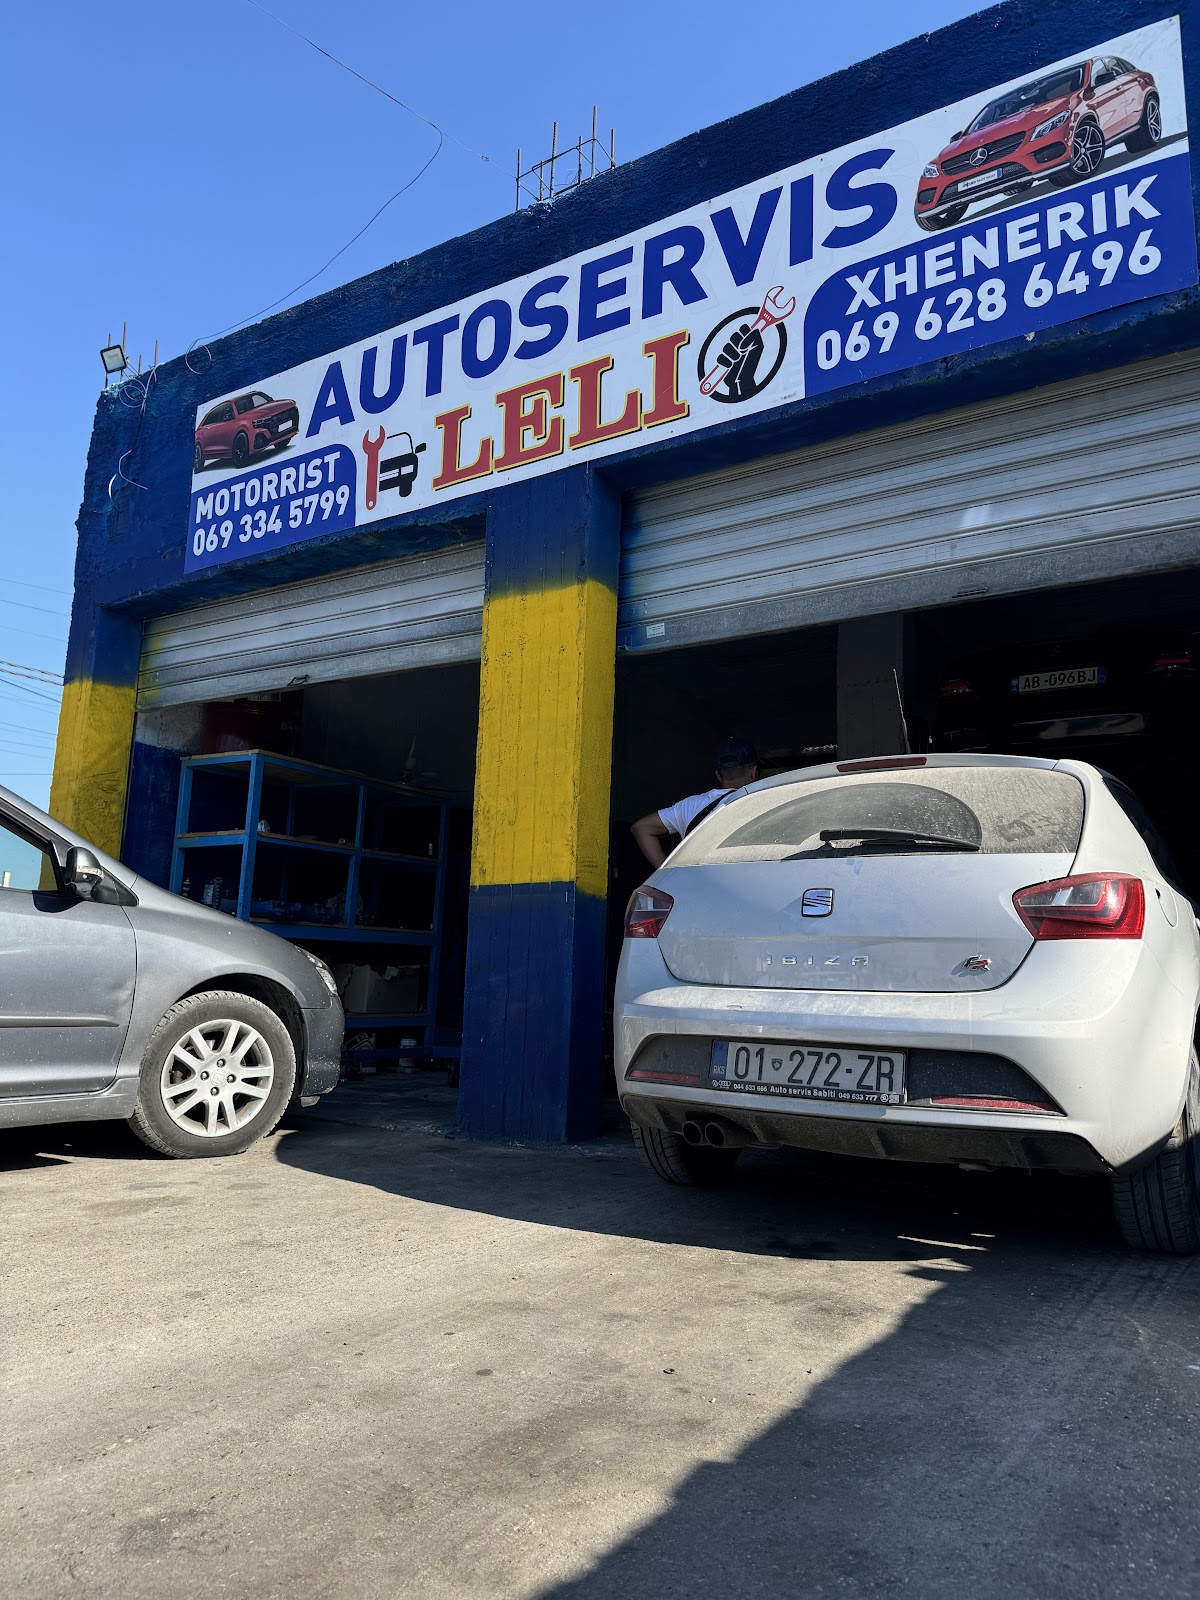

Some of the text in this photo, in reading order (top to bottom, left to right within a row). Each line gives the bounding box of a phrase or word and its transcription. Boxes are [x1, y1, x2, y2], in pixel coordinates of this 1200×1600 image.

[845, 174, 1162, 316] XHENERIK
[305, 148, 896, 438] AUTOSERVIS
[816, 228, 1163, 371] 069 628 6496
[431, 328, 691, 490] LELI
[192, 484, 350, 557] 069 334 5799
[195, 451, 341, 523] MOTORRIST
[766, 954, 870, 967] IBIZA
[734, 1046, 765, 1081] 01
[770, 1085, 787, 1094] Auto
[788, 1087, 812, 1096] servis
[812, 1088, 836, 1098] Sabiti
[851, 1093, 864, 1101] 633
[864, 1094, 879, 1102] 777
